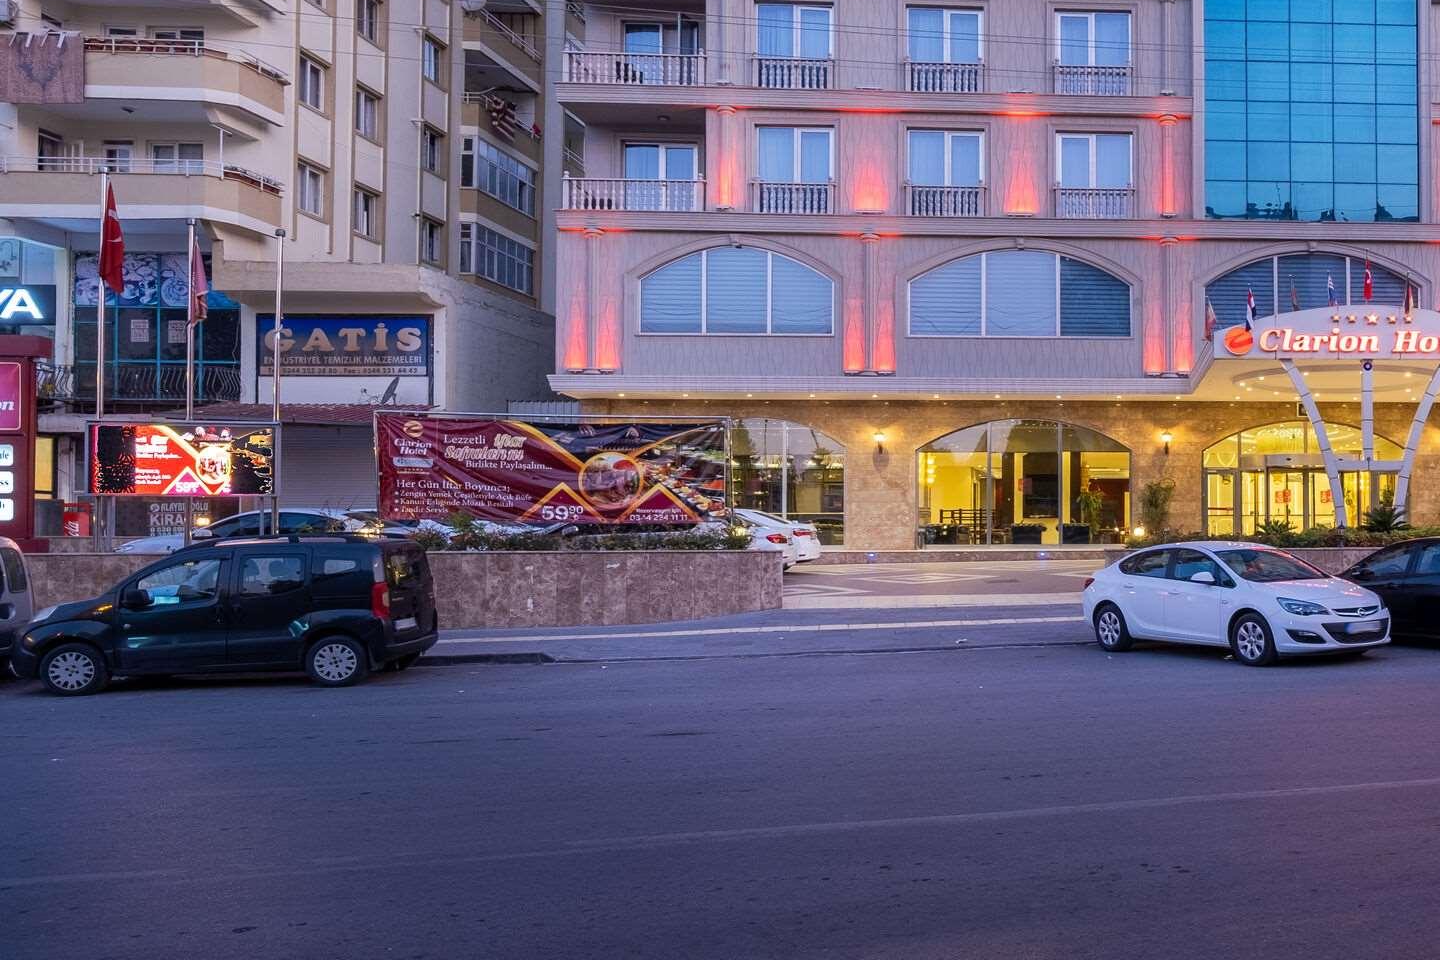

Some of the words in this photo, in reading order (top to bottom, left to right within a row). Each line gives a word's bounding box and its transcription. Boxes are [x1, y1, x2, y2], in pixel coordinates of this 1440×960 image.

[1258, 327, 1381, 354] Clarion
[394, 438, 432, 449] Clarion
[444, 434, 486, 445] Lezzetli
[400, 447, 427, 456] Hotel
[466, 460, 498, 469] Birlikte
[396, 480, 416, 489] Her
[418, 480, 440, 489] Gün
[400, 490, 427, 499] Zengin
[428, 490, 452, 498] Yemek
